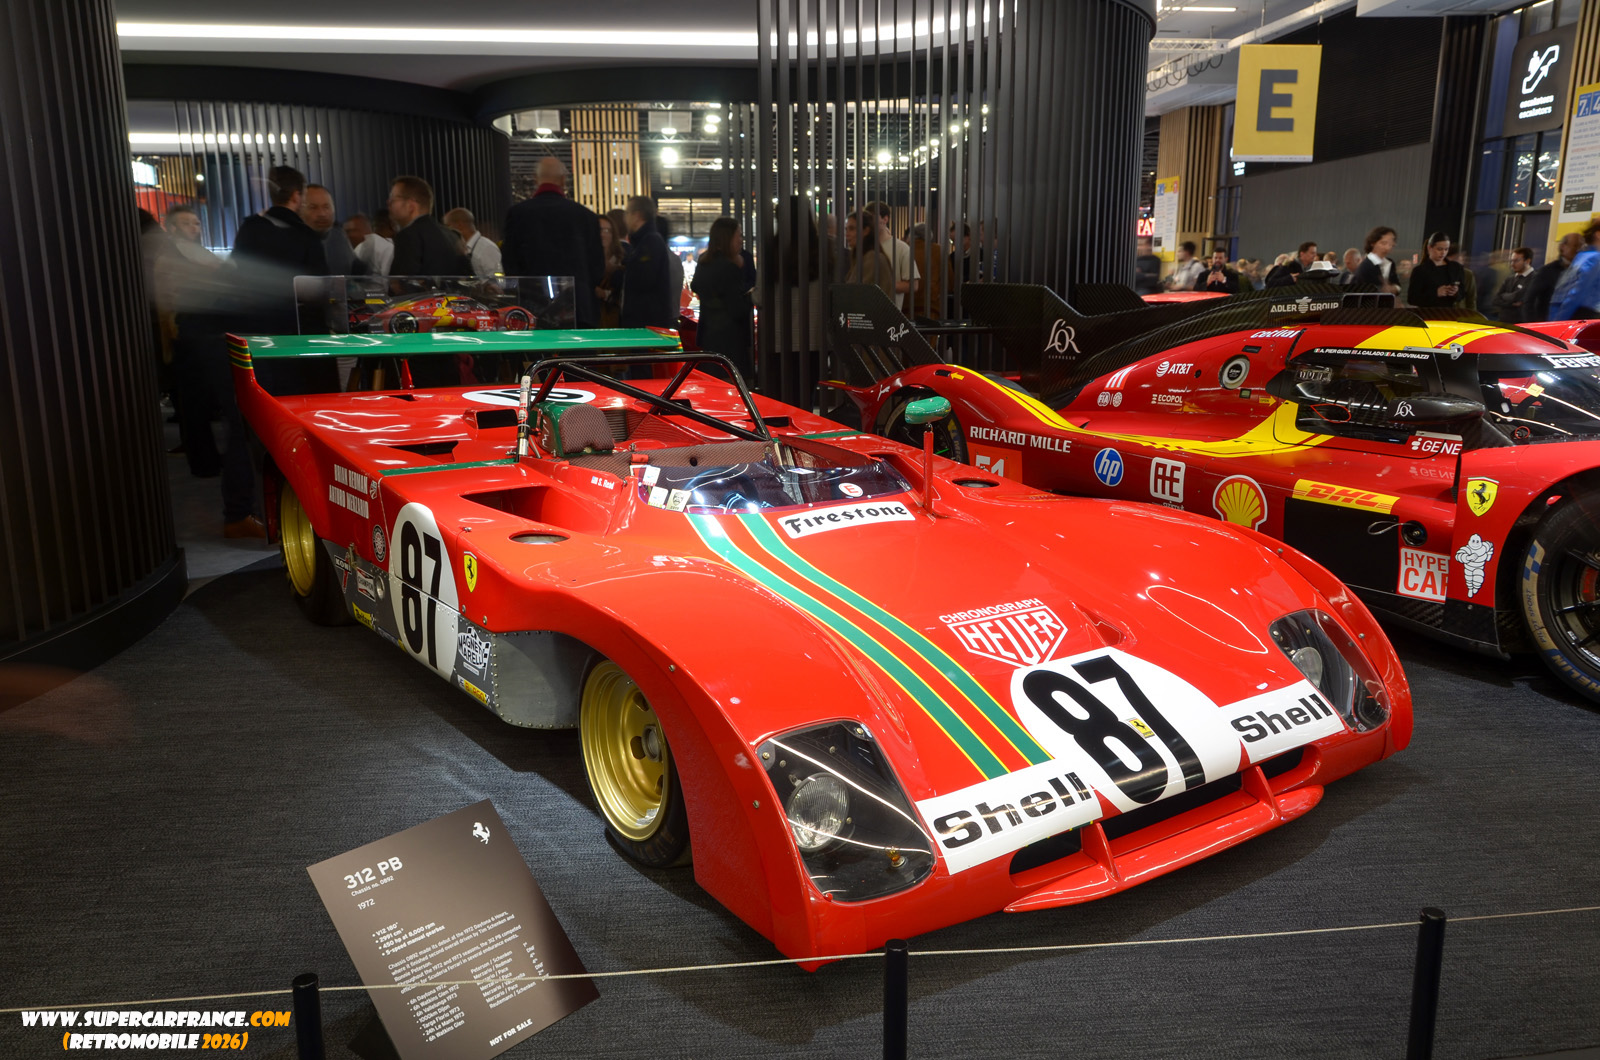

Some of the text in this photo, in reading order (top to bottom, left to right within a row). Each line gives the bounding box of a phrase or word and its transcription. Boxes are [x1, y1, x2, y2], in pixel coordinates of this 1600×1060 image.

[1256, 70, 1298, 132] E
[1270, 304, 1296, 313] ADLER
[478, 320, 488, 328] 51
[1168, 363, 1194, 375] AT&T
[1158, 394, 1183, 403] ECOPOL
[970, 426, 1072, 453] RICHARD MILLE
[1098, 448, 1121, 486] hp
[1305, 484, 1379, 508] DHL
[784, 502, 908, 534] Firestone
[1404, 552, 1450, 572] HYPE
[401, 521, 442, 670] 87
[1526, 588, 1536, 618] SPORT
[940, 598, 1043, 623] CHRONOGRAPH
[961, 610, 1062, 664] HEUER
[1232, 694, 1333, 743] Shell
[1023, 655, 1205, 804] 87
[933, 771, 1093, 849] Shell
[343, 856, 402, 888] 312 PB
[351, 885, 371, 896] Chassis
[379, 875, 394, 884] 0892
[357, 898, 375, 909] 1972
[379, 932, 393, 942] 2991
[385, 925, 445, 955] 5-speed manual gearbox
[501, 924, 521, 937] competed
[382, 940, 394, 948] 450
[388, 959, 406, 969] Chassis
[418, 946, 431, 955] made
[437, 937, 451, 946] debut
[473, 918, 491, 929] Daytona
[391, 966, 406, 975] where
[410, 954, 428, 966] finished
[428, 947, 444, 958] second
[444, 940, 459, 950] overall
[459, 934, 473, 943] driven
[486, 918, 506, 930] Schenken
[427, 968, 447, 980] Scuderia
[446, 960, 462, 970] Ferrari
[467, 950, 482, 961] several
[482, 940, 504, 953] endurance
[470, 950, 512, 973] Peterson Schenken
[494, 957, 512, 968] Redman
[393, 971, 410, 981] Ronnie
[416, 988, 436, 1001] Daytona
[515, 981, 536, 994] Schenken
[419, 995, 438, 1006] Watkins
[422, 998, 447, 1012] Vallelunga
[418, 1004, 450, 1022] 1000km Dijon
[422, 1019, 436, 1028] Targa
[435, 1012, 449, 1022] Florio
[441, 1017, 454, 1026] Mans
[435, 1025, 454, 1037] Watkins
[453, 1019, 464, 1027] Glen
[489, 1018, 532, 1046] NOT FOR SALE
